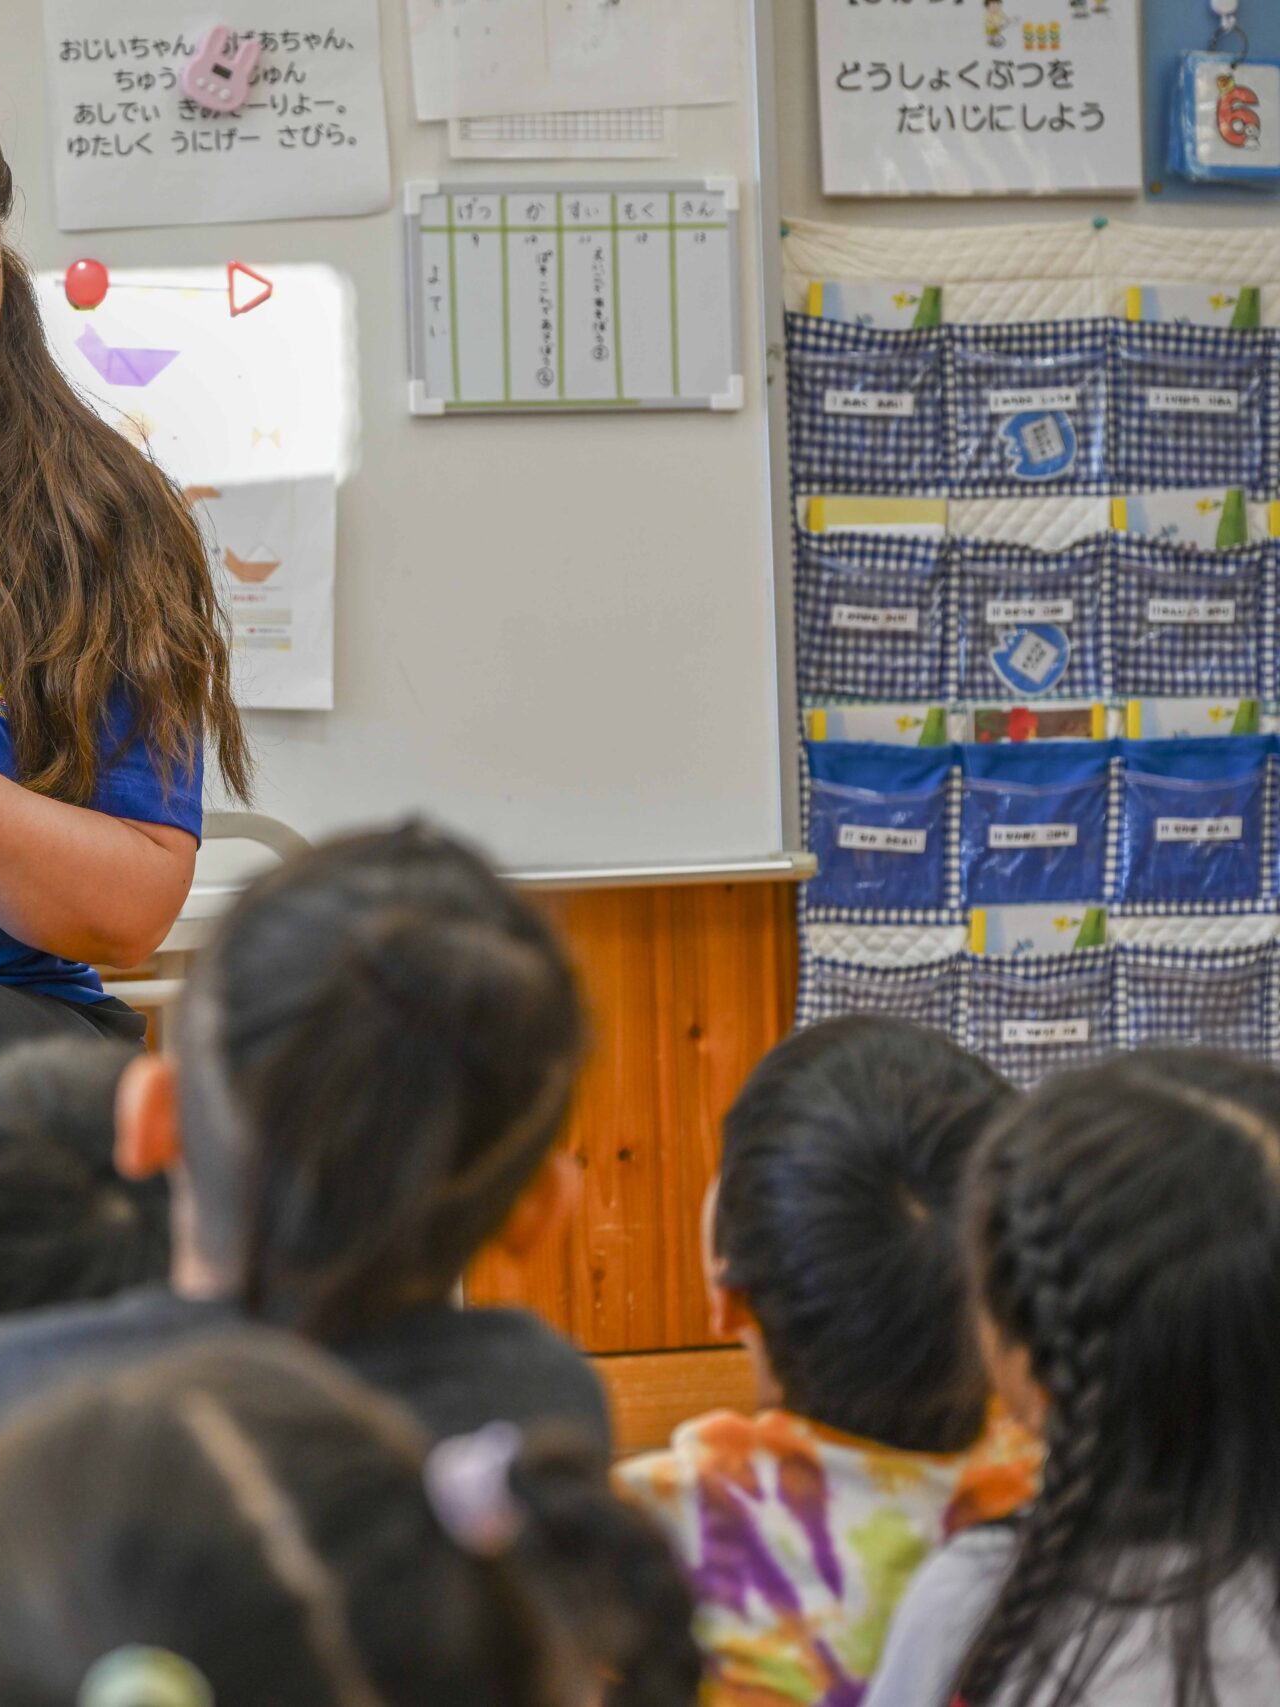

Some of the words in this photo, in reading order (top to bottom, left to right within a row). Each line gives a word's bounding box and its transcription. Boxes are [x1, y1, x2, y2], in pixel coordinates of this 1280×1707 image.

[836, 60, 1074, 91] どうしょくぶつを
[897, 103, 1105, 134] だいじにしよう
[1216, 85, 1261, 149] 6
[68, 132, 153, 157] ゆたしく
